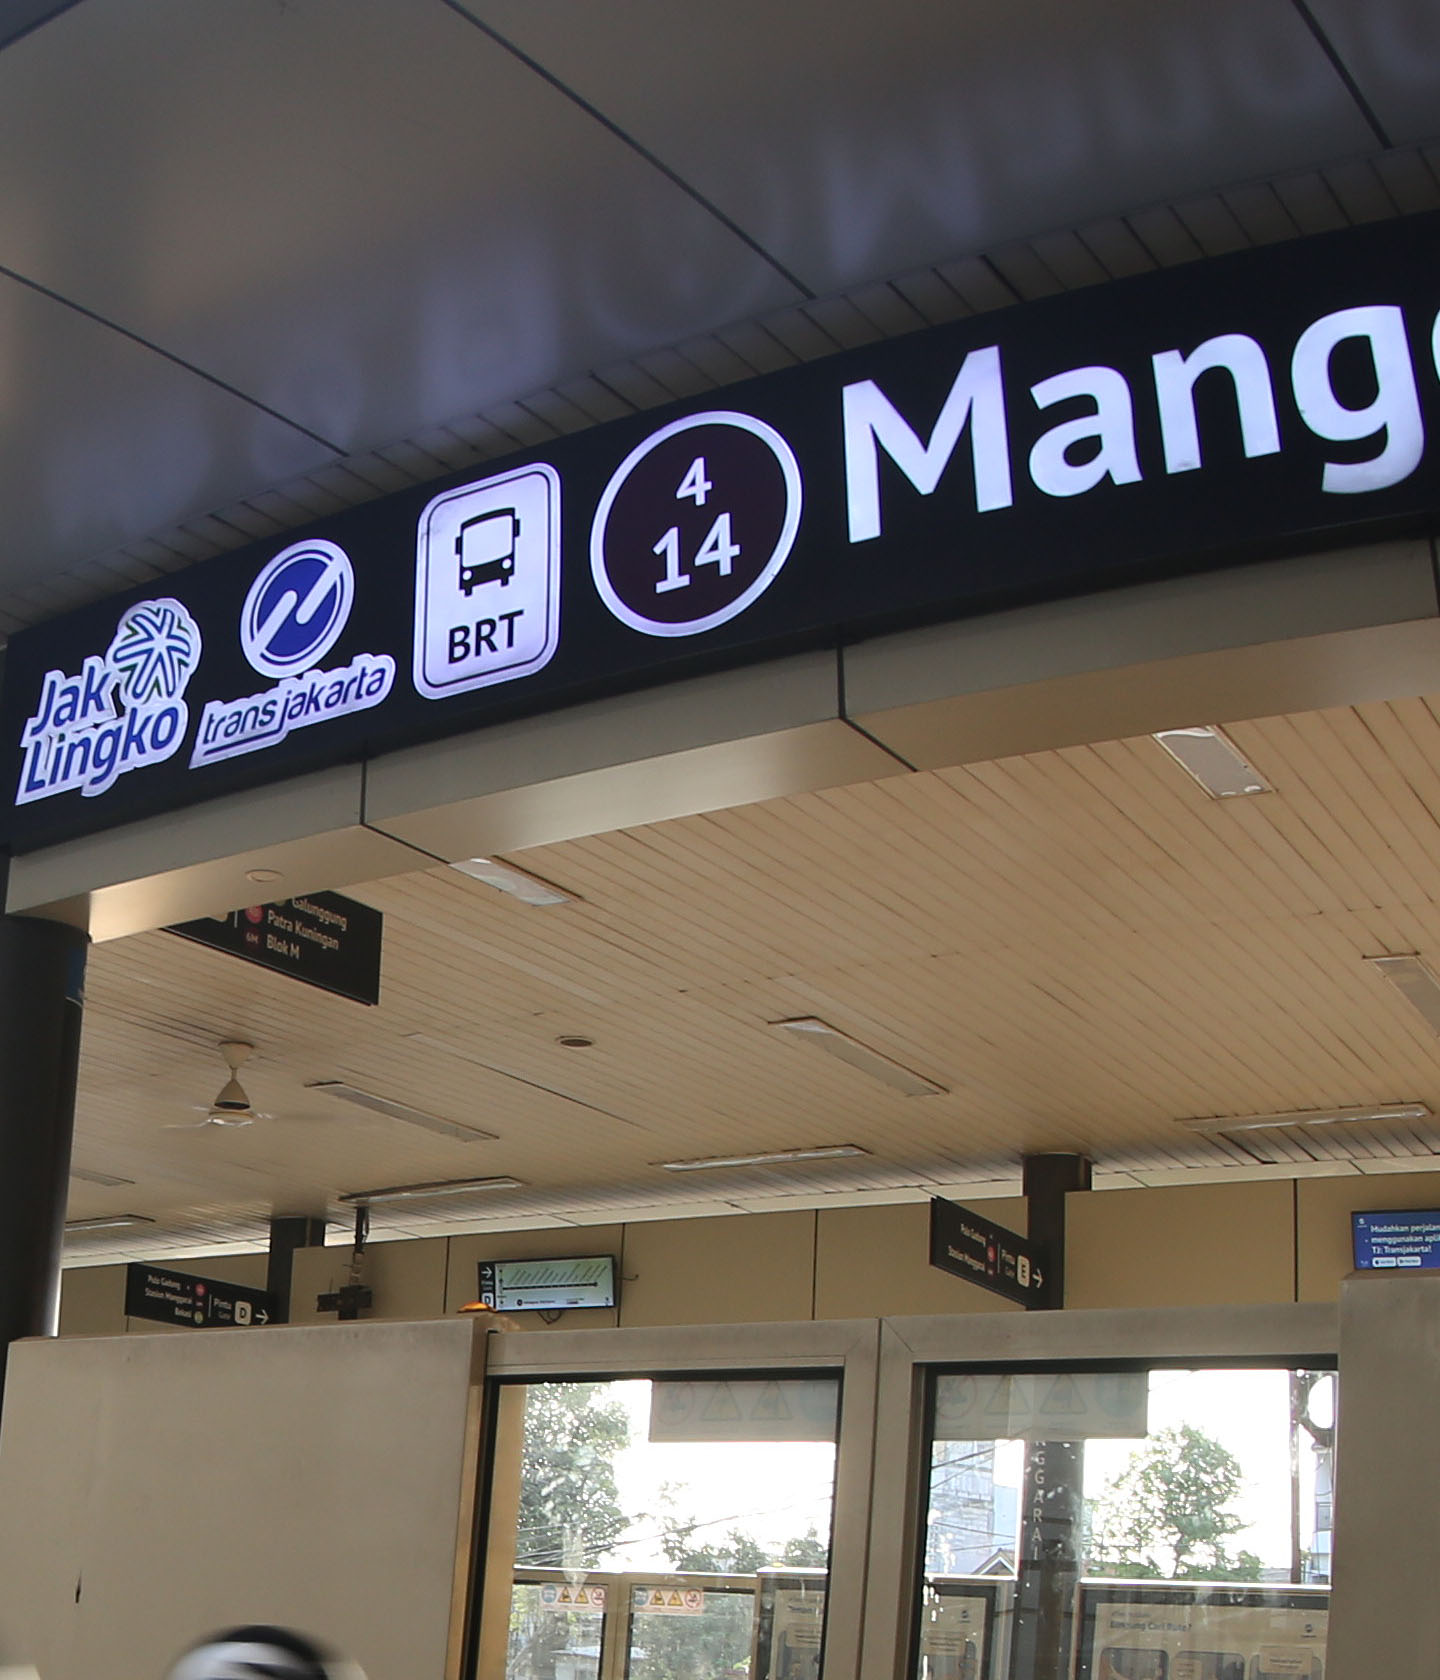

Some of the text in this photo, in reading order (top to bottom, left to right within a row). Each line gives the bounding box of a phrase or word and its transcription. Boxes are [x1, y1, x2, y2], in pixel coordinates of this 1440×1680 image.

[676, 456, 712, 506] 4
[653, 512, 740, 594] 14
[448, 609, 524, 664] BRT
[31, 664, 111, 736] Jak
[202, 665, 385, 746] transjakarta
[25, 706, 179, 785] Lingko
[267, 934, 300, 960] Blok M
[268, 910, 339, 950] Patra Kuningan
[1370, 1223, 1409, 1233] Mudahkan
[1370, 1235, 1423, 1245] menggunakan
[239, 1307, 247, 1318] D
